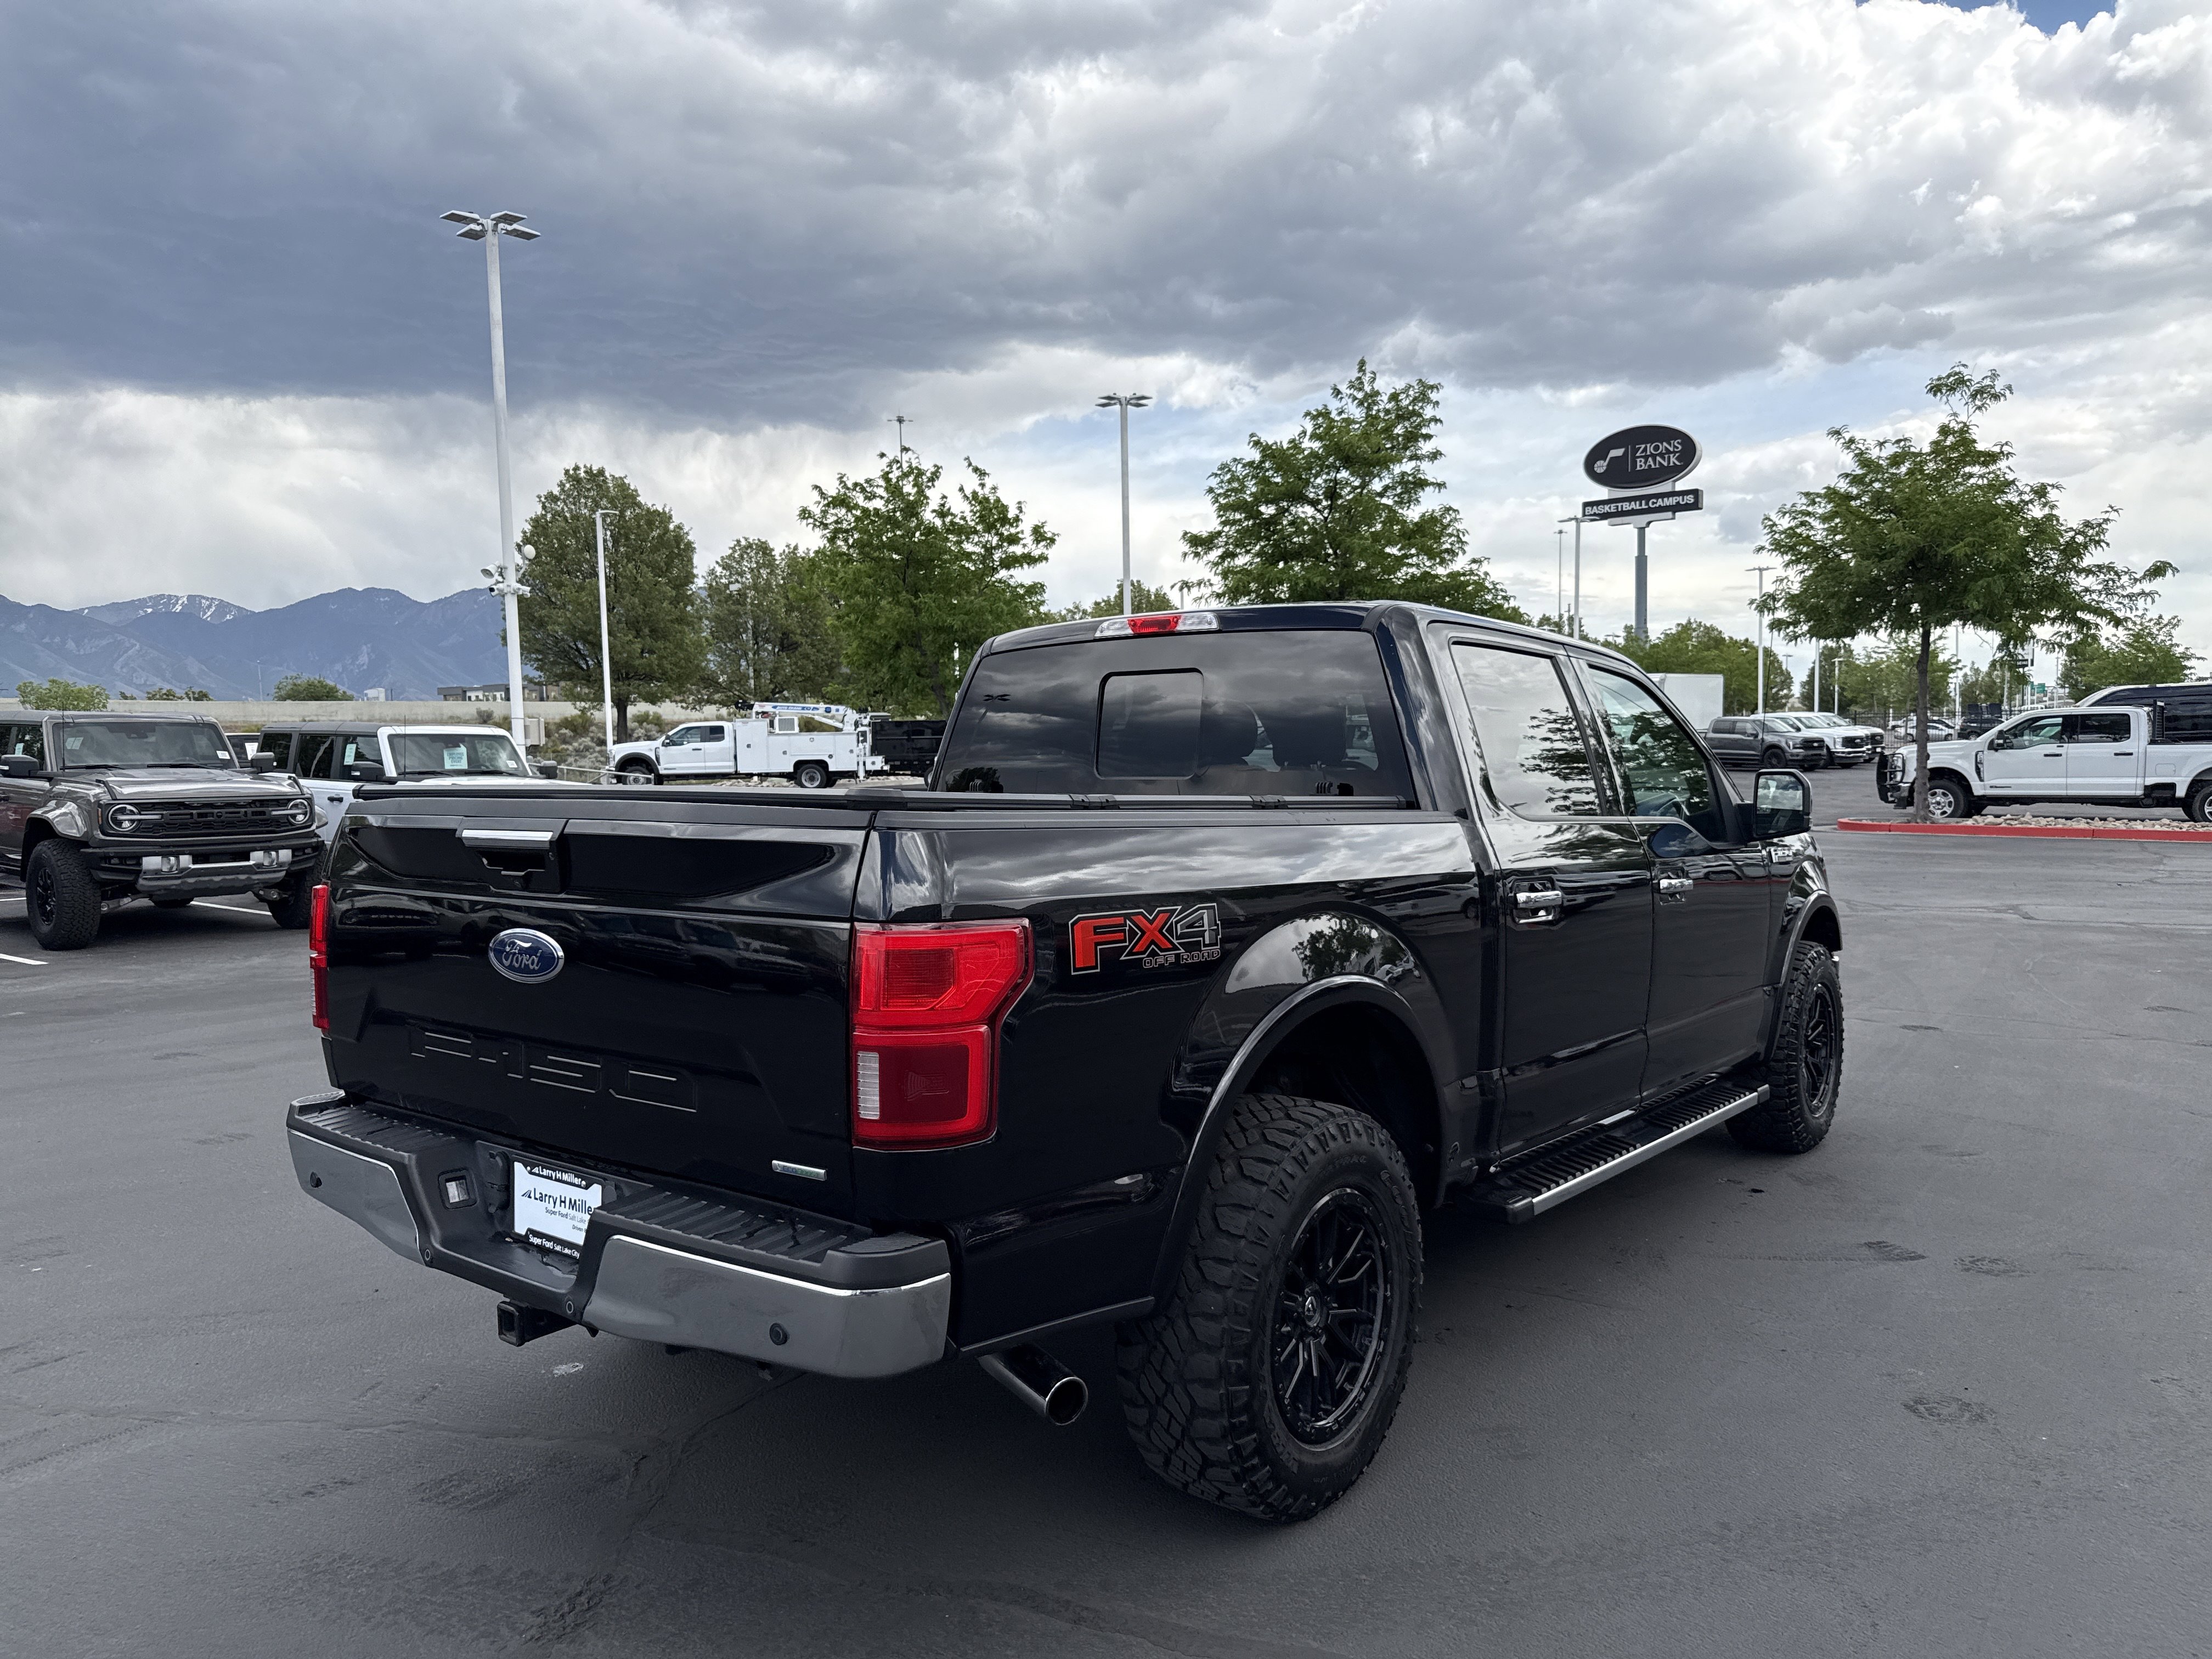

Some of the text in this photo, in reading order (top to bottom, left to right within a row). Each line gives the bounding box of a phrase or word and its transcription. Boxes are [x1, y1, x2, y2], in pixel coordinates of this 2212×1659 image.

[1635, 439, 1682, 456] ZIONS
[1635, 453, 1682, 471] BANK
[1585, 495, 1695, 515] BASKETBALL CAMPUS
[1069, 903, 1221, 975] FX4
[502, 939, 543, 970] Ford
[1143, 949, 1221, 969] OFF ROAD
[539, 1166, 582, 1185] Larry H Miller
[534, 1188, 592, 1216] Larry H Mille
[545, 1207, 557, 1216] Super
[558, 1210, 568, 1219] Ford
[529, 1234, 543, 1245] Super
[543, 1238, 553, 1249] Ford
[554, 1243, 562, 1252] Salt
[562, 1246, 572, 1255] Lake
